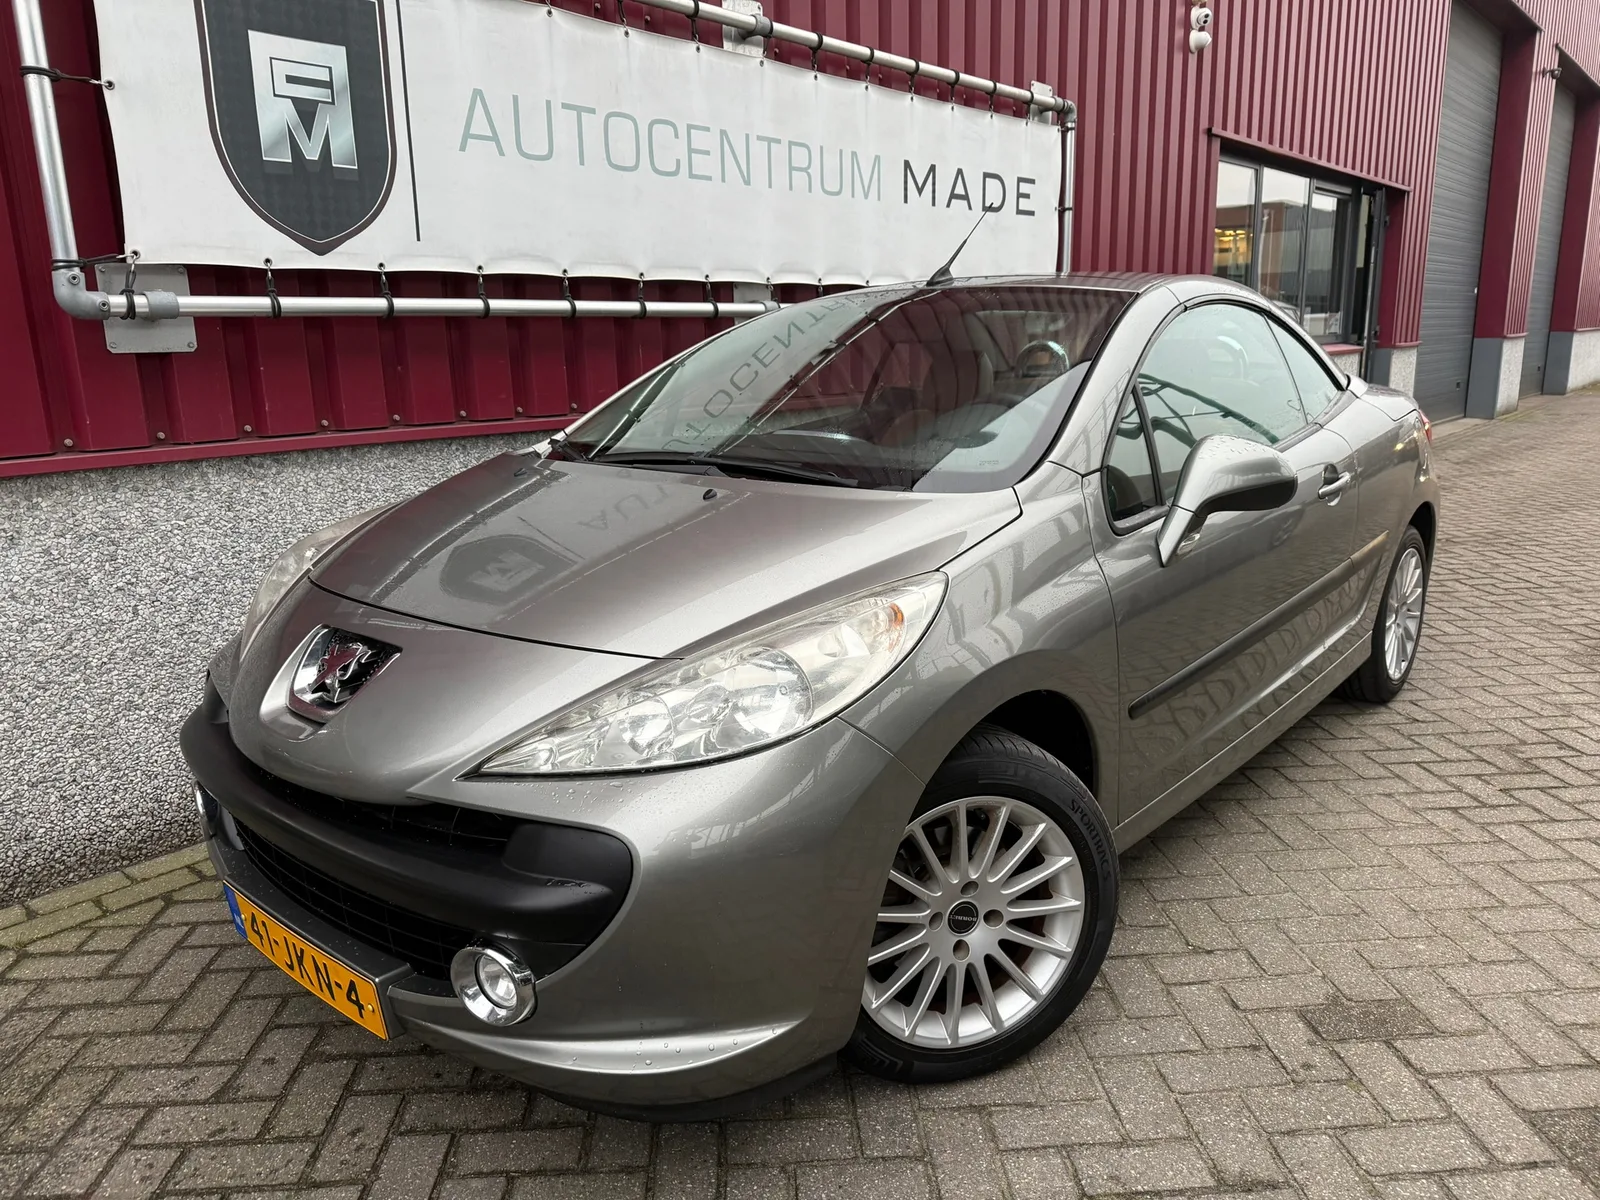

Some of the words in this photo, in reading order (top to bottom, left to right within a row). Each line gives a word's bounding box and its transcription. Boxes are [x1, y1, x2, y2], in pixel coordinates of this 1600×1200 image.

[458, 87, 881, 202] AUTOCENTRUM
[903, 158, 1036, 217] MADE
[1068, 799, 1110, 871] SPORTRAC
[250, 911, 365, 1019] 41-JKN-4
